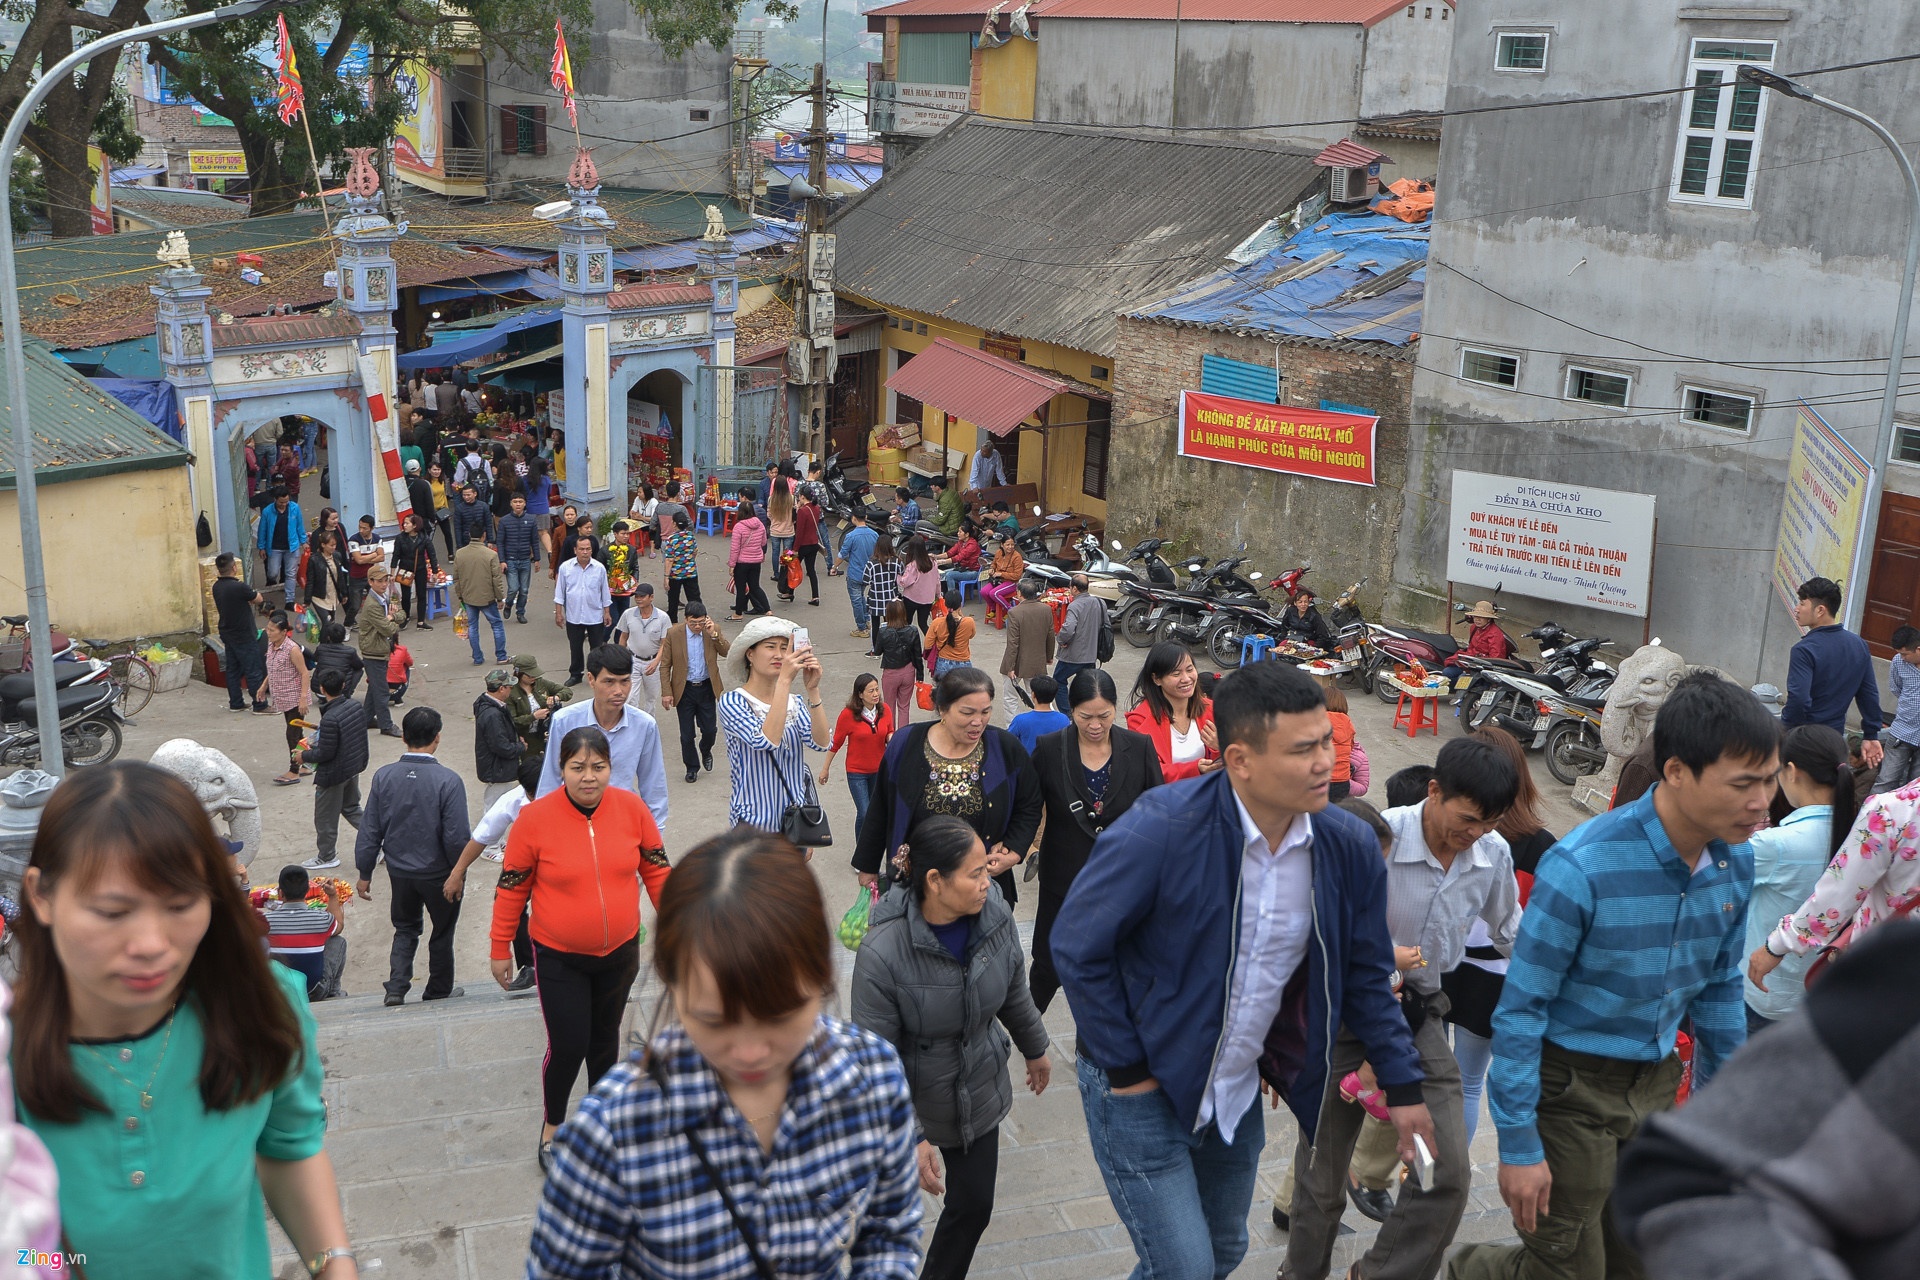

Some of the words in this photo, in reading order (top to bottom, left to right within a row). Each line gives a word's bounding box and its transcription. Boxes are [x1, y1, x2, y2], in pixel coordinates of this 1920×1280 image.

[1197, 409, 1234, 427] KHÔNG
[1236, 412, 1254, 430] ĐỂ
[1254, 415, 1277, 433] XẢY
[1280, 422, 1295, 436] RA
[1298, 424, 1332, 443] CHÁY,
[1336, 426, 1355, 444] NỔ
[1191, 428, 1204, 443] LÀ
[1206, 432, 1235, 448] HẠNH
[1238, 437, 1268, 454] PHÚC
[1271, 440, 1295, 458] CỦA
[1298, 444, 1322, 462] MỖI
[1326, 451, 1365, 469] NGƯỜI
[1495, 493, 1518, 505] ĐỀN
[1522, 498, 1537, 508] BÀ
[1540, 502, 1571, 514] CHÚA
[1576, 506, 1602, 518] KHO
[1517, 486, 1526, 494] DI
[1528, 486, 1546, 497] TÍCH
[1548, 491, 1567, 500] LỊCH
[1570, 492, 1581, 502] SỬ
[1470, 512, 1486, 522] QUÝ
[1488, 514, 1515, 527] KHÁCH
[1469, 528, 1487, 539] MUA
[1519, 535, 1536, 547] TÂM
[1542, 539, 1556, 550] GIÁ
[1559, 540, 1570, 552] CẢ
[1574, 542, 1594, 556] THỎA
[1598, 548, 1627, 562] THUẬN
[1469, 541, 1483, 553] TRẢ
[1506, 548, 1532, 561] TRƯỚC
[1534, 553, 1548, 564] KHI
[1584, 561, 1600, 573] LÊN
[1466, 557, 1484, 568] Chúc
[1485, 564, 1498, 572] quý
[1500, 564, 1522, 575] khách
[1524, 569, 1537, 578] An
[1540, 571, 1568, 584] Khang
[1574, 577, 1597, 589] Thịnh
[1599, 582, 1627, 596] Vượng
[1626, 601, 1636, 609] TÍCH
